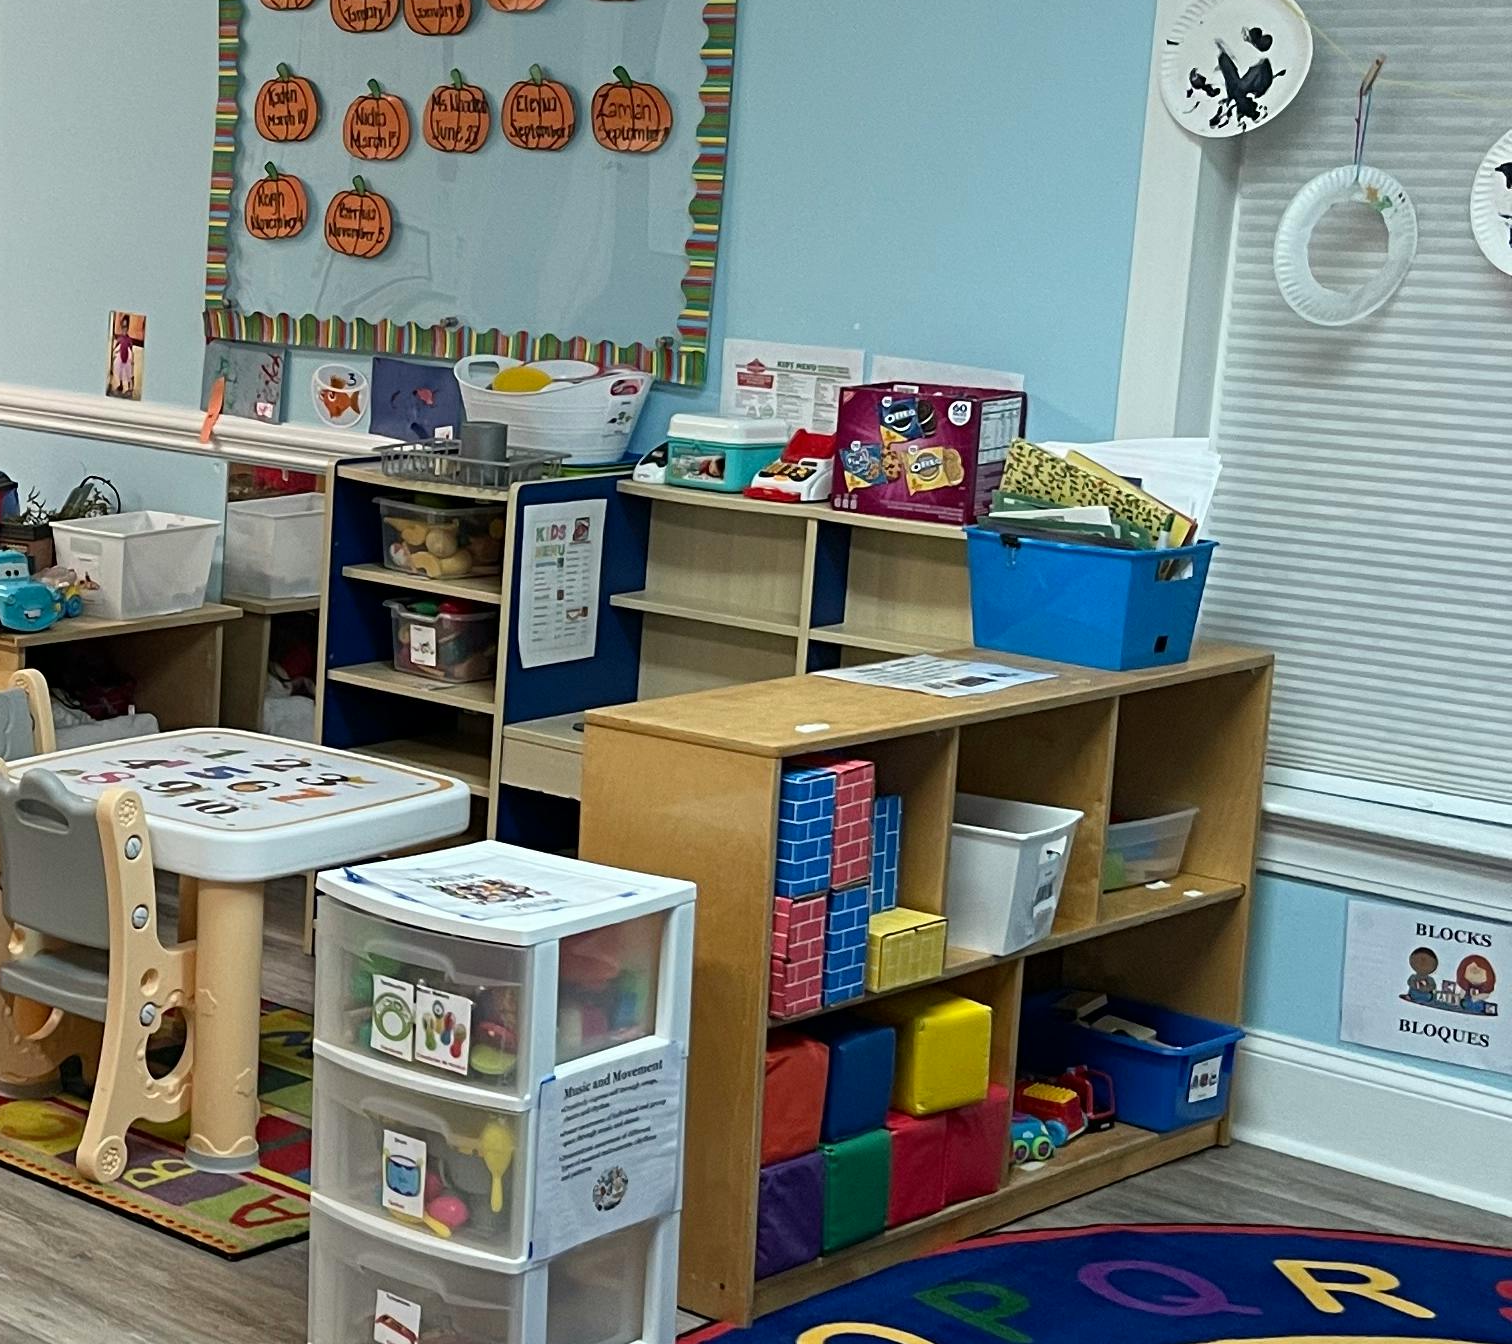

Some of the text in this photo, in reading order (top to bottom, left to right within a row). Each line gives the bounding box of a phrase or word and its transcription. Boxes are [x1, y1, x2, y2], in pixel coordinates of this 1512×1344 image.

[267, 112, 296, 127] March
[433, 120, 463, 142] June
[351, 131, 388, 149] March
[346, 372, 358, 387] 3
[535, 523, 568, 543] KIDS
[1415, 922, 1493, 948] BLOCKS
[1398, 1018, 1490, 1048] BLOQUES
[563, 1059, 664, 1099] Music and Movement
[1076, 1260, 1263, 1318] Q
[1272, 1258, 1436, 1320] R
